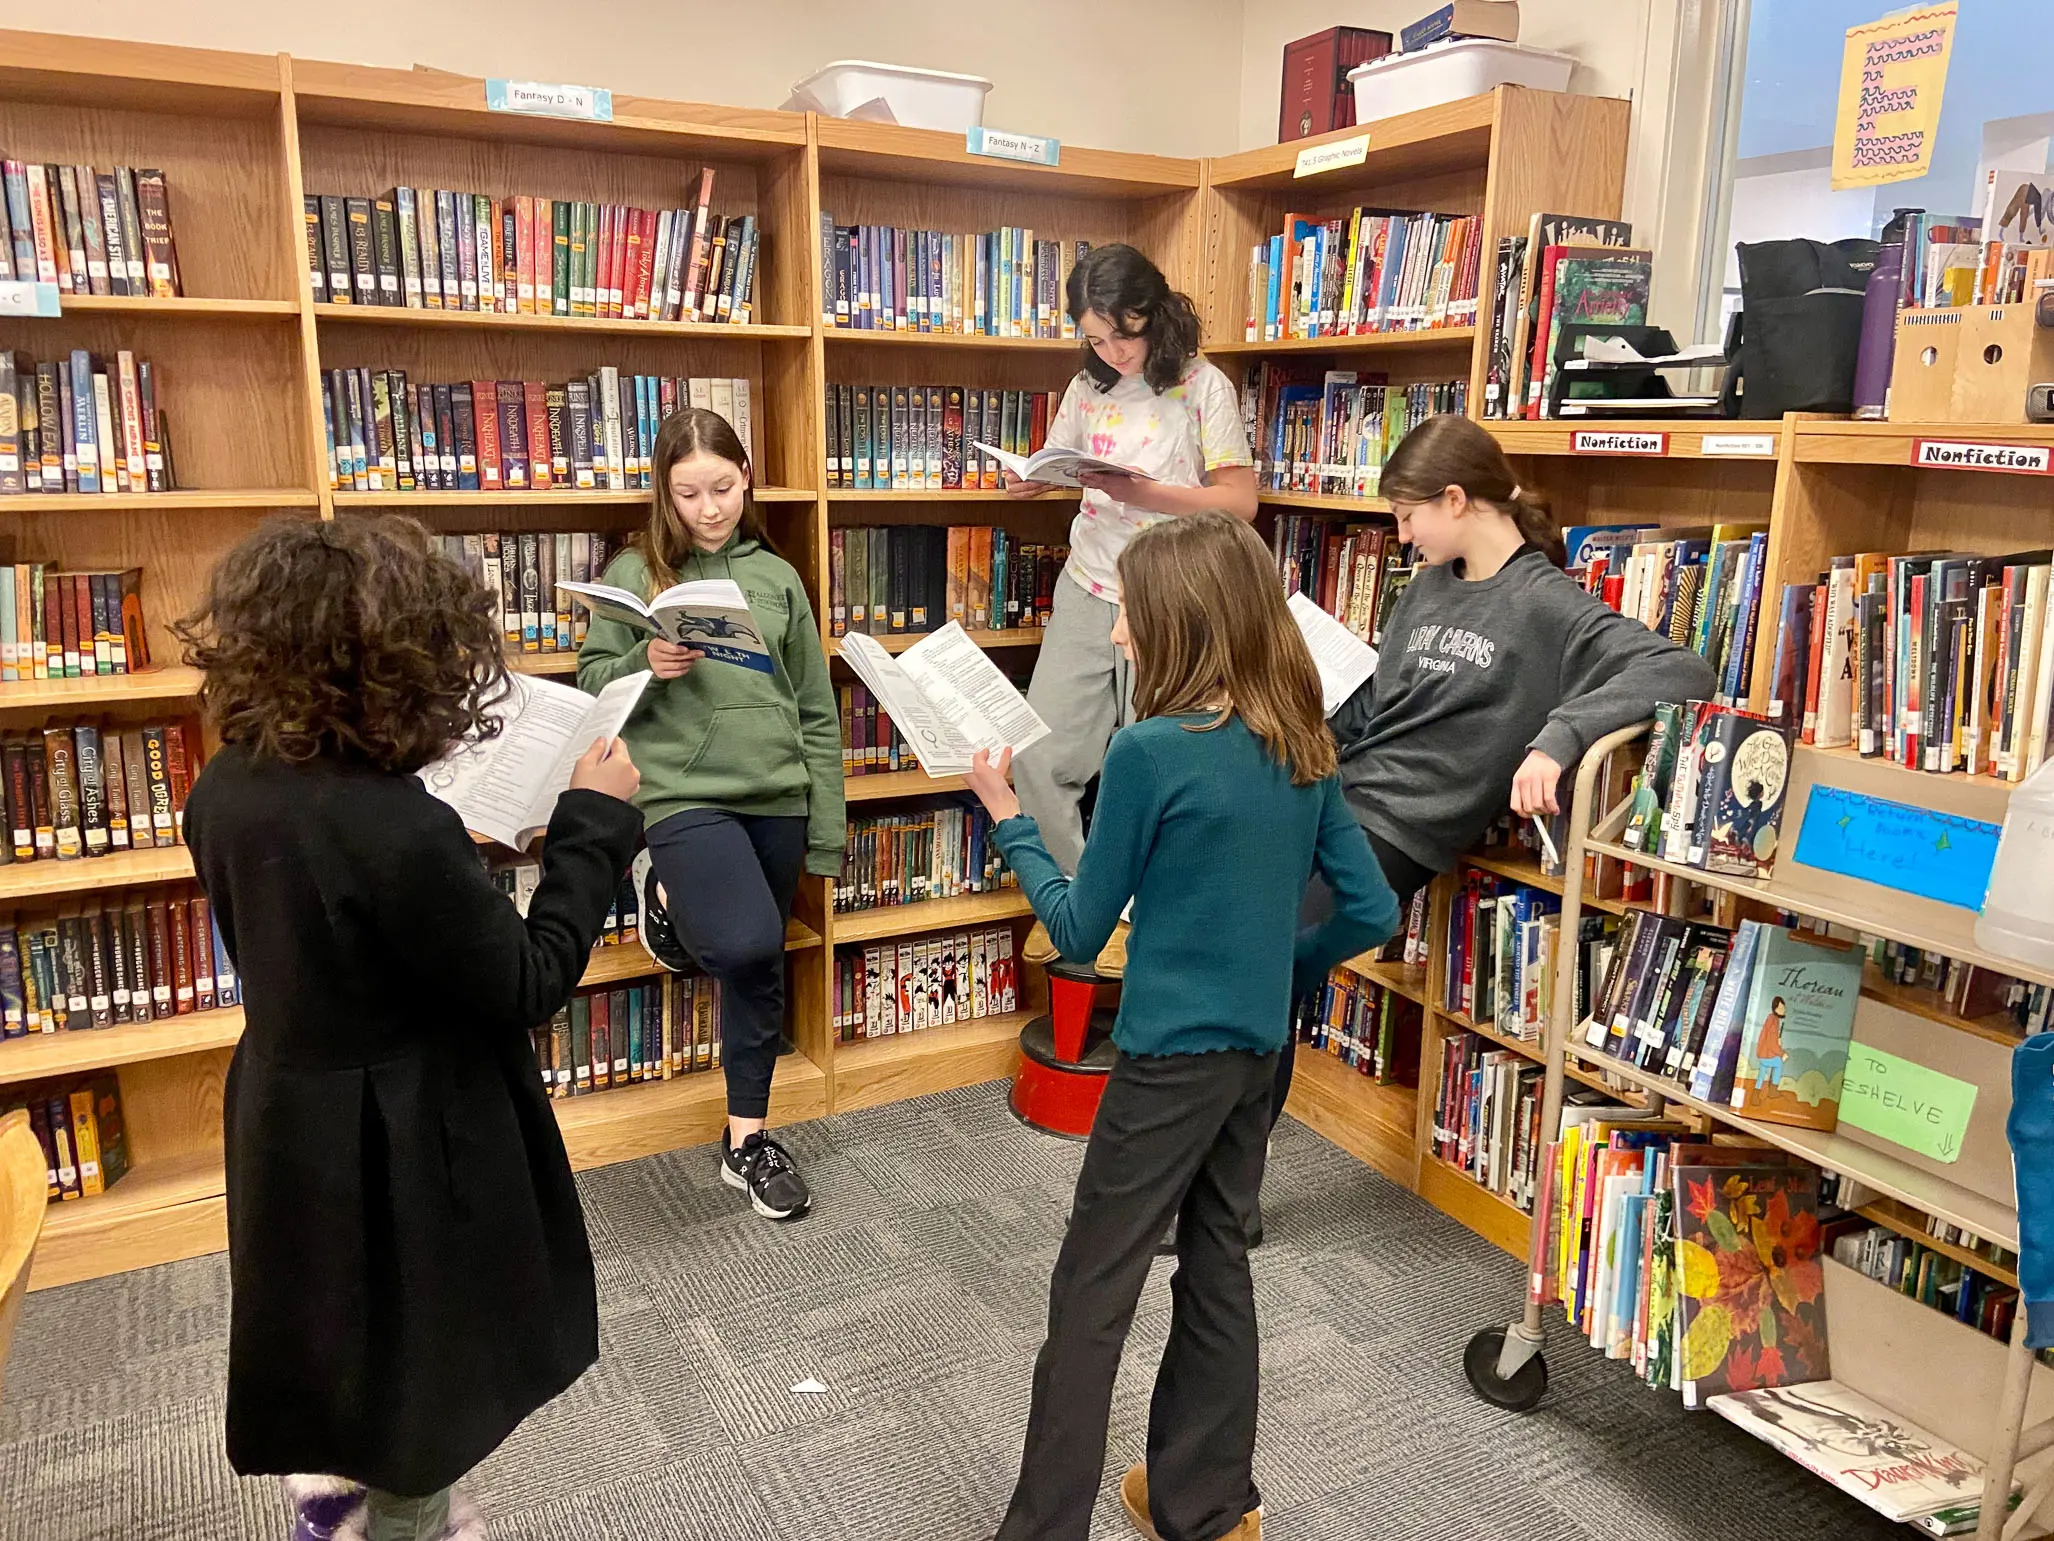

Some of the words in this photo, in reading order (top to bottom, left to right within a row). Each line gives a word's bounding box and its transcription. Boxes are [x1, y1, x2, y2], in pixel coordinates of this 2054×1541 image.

[514, 89, 553, 104] Fantasy
[557, 95, 565, 104] D
[576, 97, 583, 106] N
[1851, 26, 1946, 169] E
[989, 136, 1018, 150] Fantasy
[1020, 141, 1027, 150] N
[1318, 152, 1340, 164] Graphic
[1342, 146, 1362, 157] Novels
[102, 197, 120, 244] AMERICAN
[145, 209, 163, 217] THE
[144, 223, 168, 231] BOOK
[145, 237, 169, 245] THIEF
[640, 250, 651, 268] Toby
[823, 237, 833, 300] ERAGON
[639, 269, 650, 298] Alone
[1498, 262, 1508, 296] AVATAR
[12, 293, 21, 303] C
[39, 373, 55, 430] HOLLOW
[126, 390, 138, 421] CIRCUS
[75, 395, 88, 440] MERLIN
[507, 404, 520, 450] INKDEATH
[549, 407, 563, 455] INKDEATH
[574, 413, 588, 458] INKSPELL
[1580, 435, 1658, 450] Nonfiction
[1925, 445, 2042, 469] Nonfiction
[1355, 563, 1364, 583] Queen
[1365, 563, 1376, 583] Queen
[1683, 712, 1695, 744] HENDRIX
[52, 749, 68, 775] City
[80, 746, 97, 773] City
[147, 739, 163, 781] GOOD
[1679, 755, 1689, 771] THE
[56, 777, 68, 787] of
[83, 775, 97, 786] of
[57, 789, 73, 822] Glass
[84, 787, 101, 824] Ashes
[1867, 802, 1924, 824] Return
[176, 931, 186, 966] CATCHING
[198, 927, 208, 962] CATCHING
[92, 952, 102, 978] HUNGER
[114, 946, 124, 972] HUNGER
[133, 947, 144, 972] HUNGER
[177, 967, 187, 984] FIRE
[1600, 958, 1622, 1013] MONTMORENCY
[1777, 966, 1844, 998] Thoreau
[1864, 1058, 1887, 1074] TO
[1842, 1078, 1944, 1125] ESHELVE
